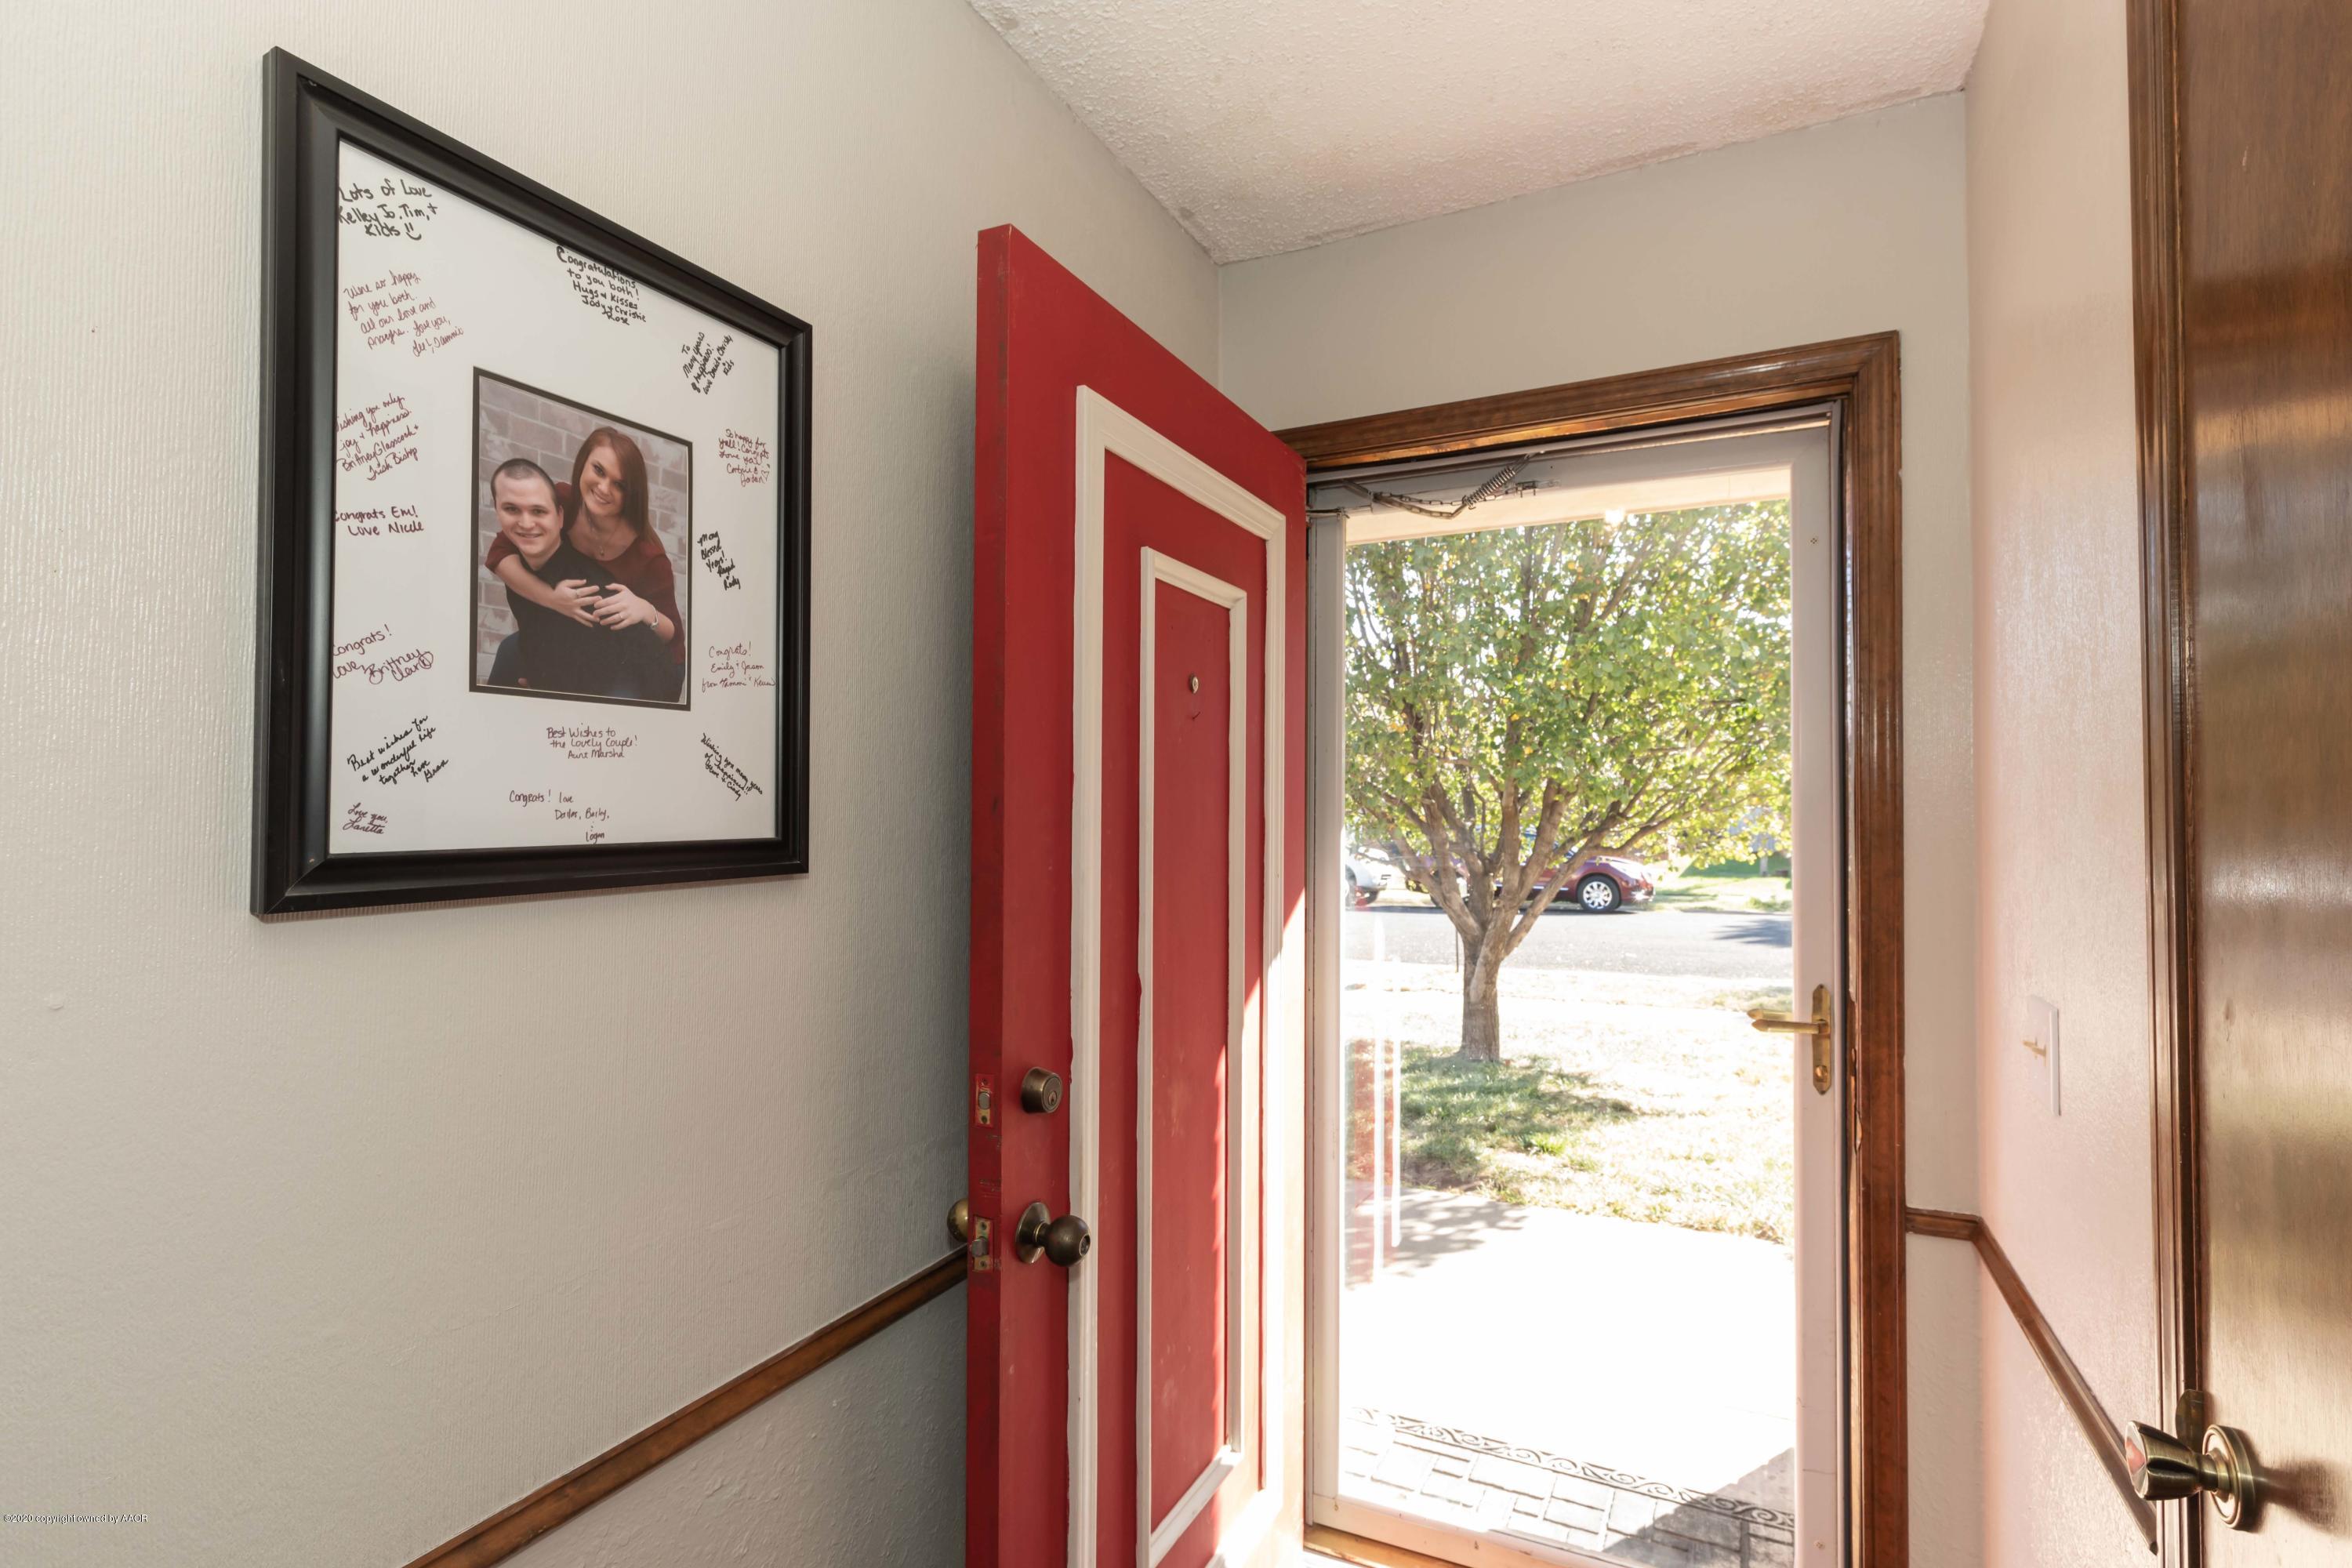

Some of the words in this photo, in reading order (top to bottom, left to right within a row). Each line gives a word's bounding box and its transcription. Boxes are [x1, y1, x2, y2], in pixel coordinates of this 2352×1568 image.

[339, 183, 373, 202] Lots
[380, 178, 395, 196] of
[401, 179, 432, 198] Love
[376, 279, 386, 290] so
[389, 270, 421, 287] happy
[567, 268, 582, 279] to
[586, 274, 604, 287] you
[573, 280, 599, 299] Hugs
[348, 300, 364, 321] for
[368, 299, 389, 316] you
[379, 315, 394, 328] our
[397, 307, 417, 321] love
[419, 296, 437, 312] and
[413, 319, 431, 337] Love
[681, 344, 691, 355] To
[336, 408, 368, 432] ishing
[366, 405, 380, 423] you
[339, 439, 361, 458] joy
[391, 505, 418, 517] Em!
[347, 525, 379, 535] Love
[710, 662, 735, 678] Emily
[546, 727, 566, 739] Best
[606, 727, 616, 737] to
[347, 750, 375, 771] Best
[412, 715, 428, 731] for
[550, 739, 565, 748] the
[347, 802, 368, 818] Love
